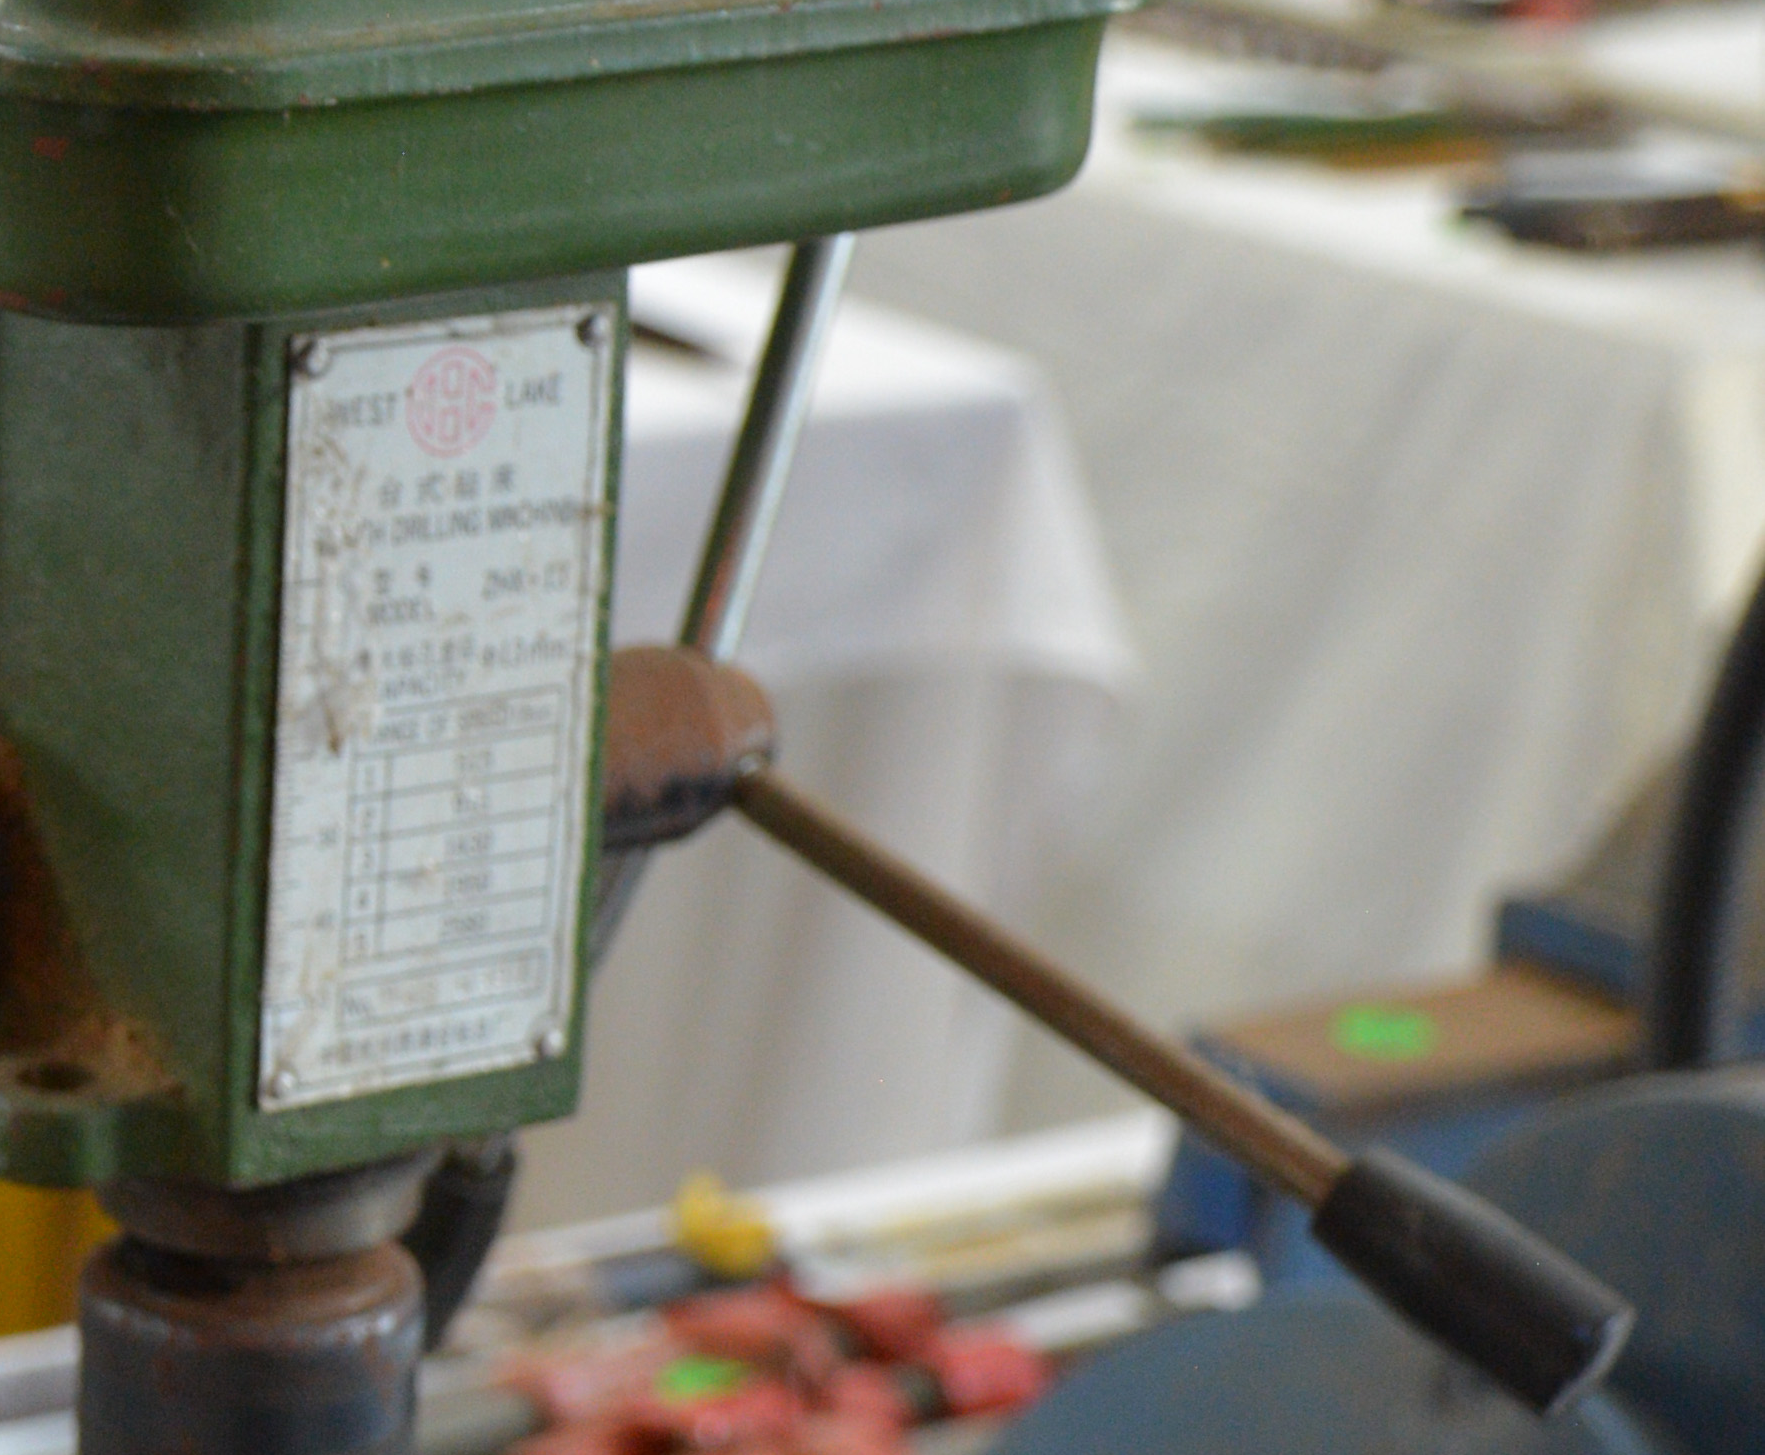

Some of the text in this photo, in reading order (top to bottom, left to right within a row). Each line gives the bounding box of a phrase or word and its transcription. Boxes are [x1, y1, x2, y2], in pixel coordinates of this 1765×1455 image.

[324, 371, 563, 427] WEST LAKE
[390, 507, 482, 543] DRILLING
[367, 596, 434, 627] MODEL
[374, 666, 466, 699] APACITY
